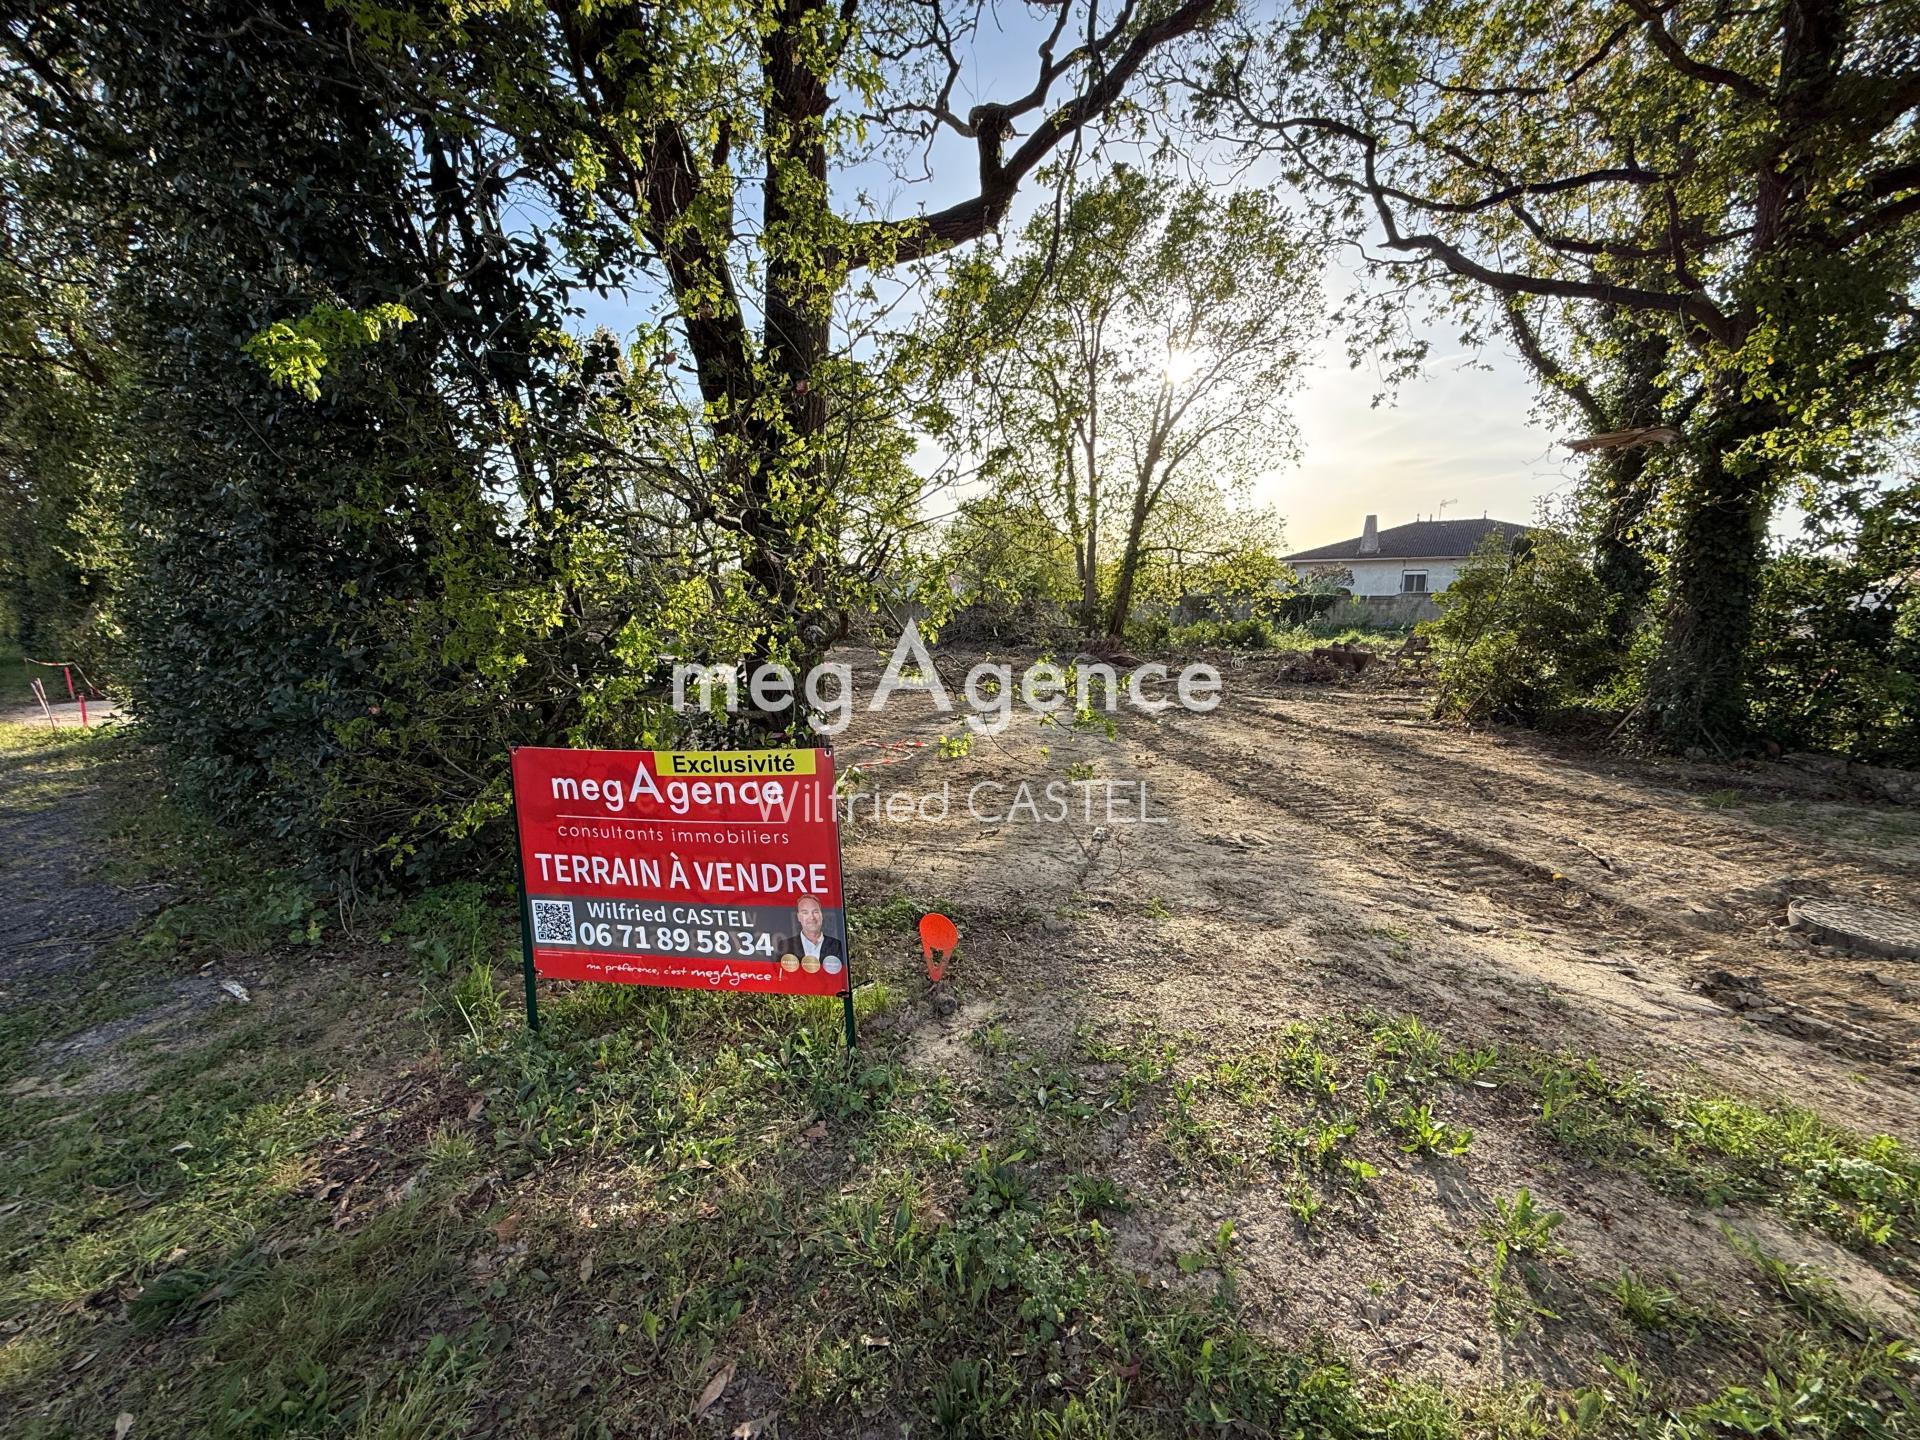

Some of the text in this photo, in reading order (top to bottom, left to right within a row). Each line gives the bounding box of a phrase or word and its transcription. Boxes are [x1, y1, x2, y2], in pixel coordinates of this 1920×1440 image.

[672, 753, 796, 774] Exclusivité
[551, 761, 784, 815] megAgence
[557, 824, 790, 845] consultants immobiliers
[534, 852, 829, 894] TERRAIN À VENDRE
[586, 901, 755, 928] Wilfried CASTEL
[579, 922, 775, 957] 06 71 89 58 34
[690, 964, 772, 986] megAgence
